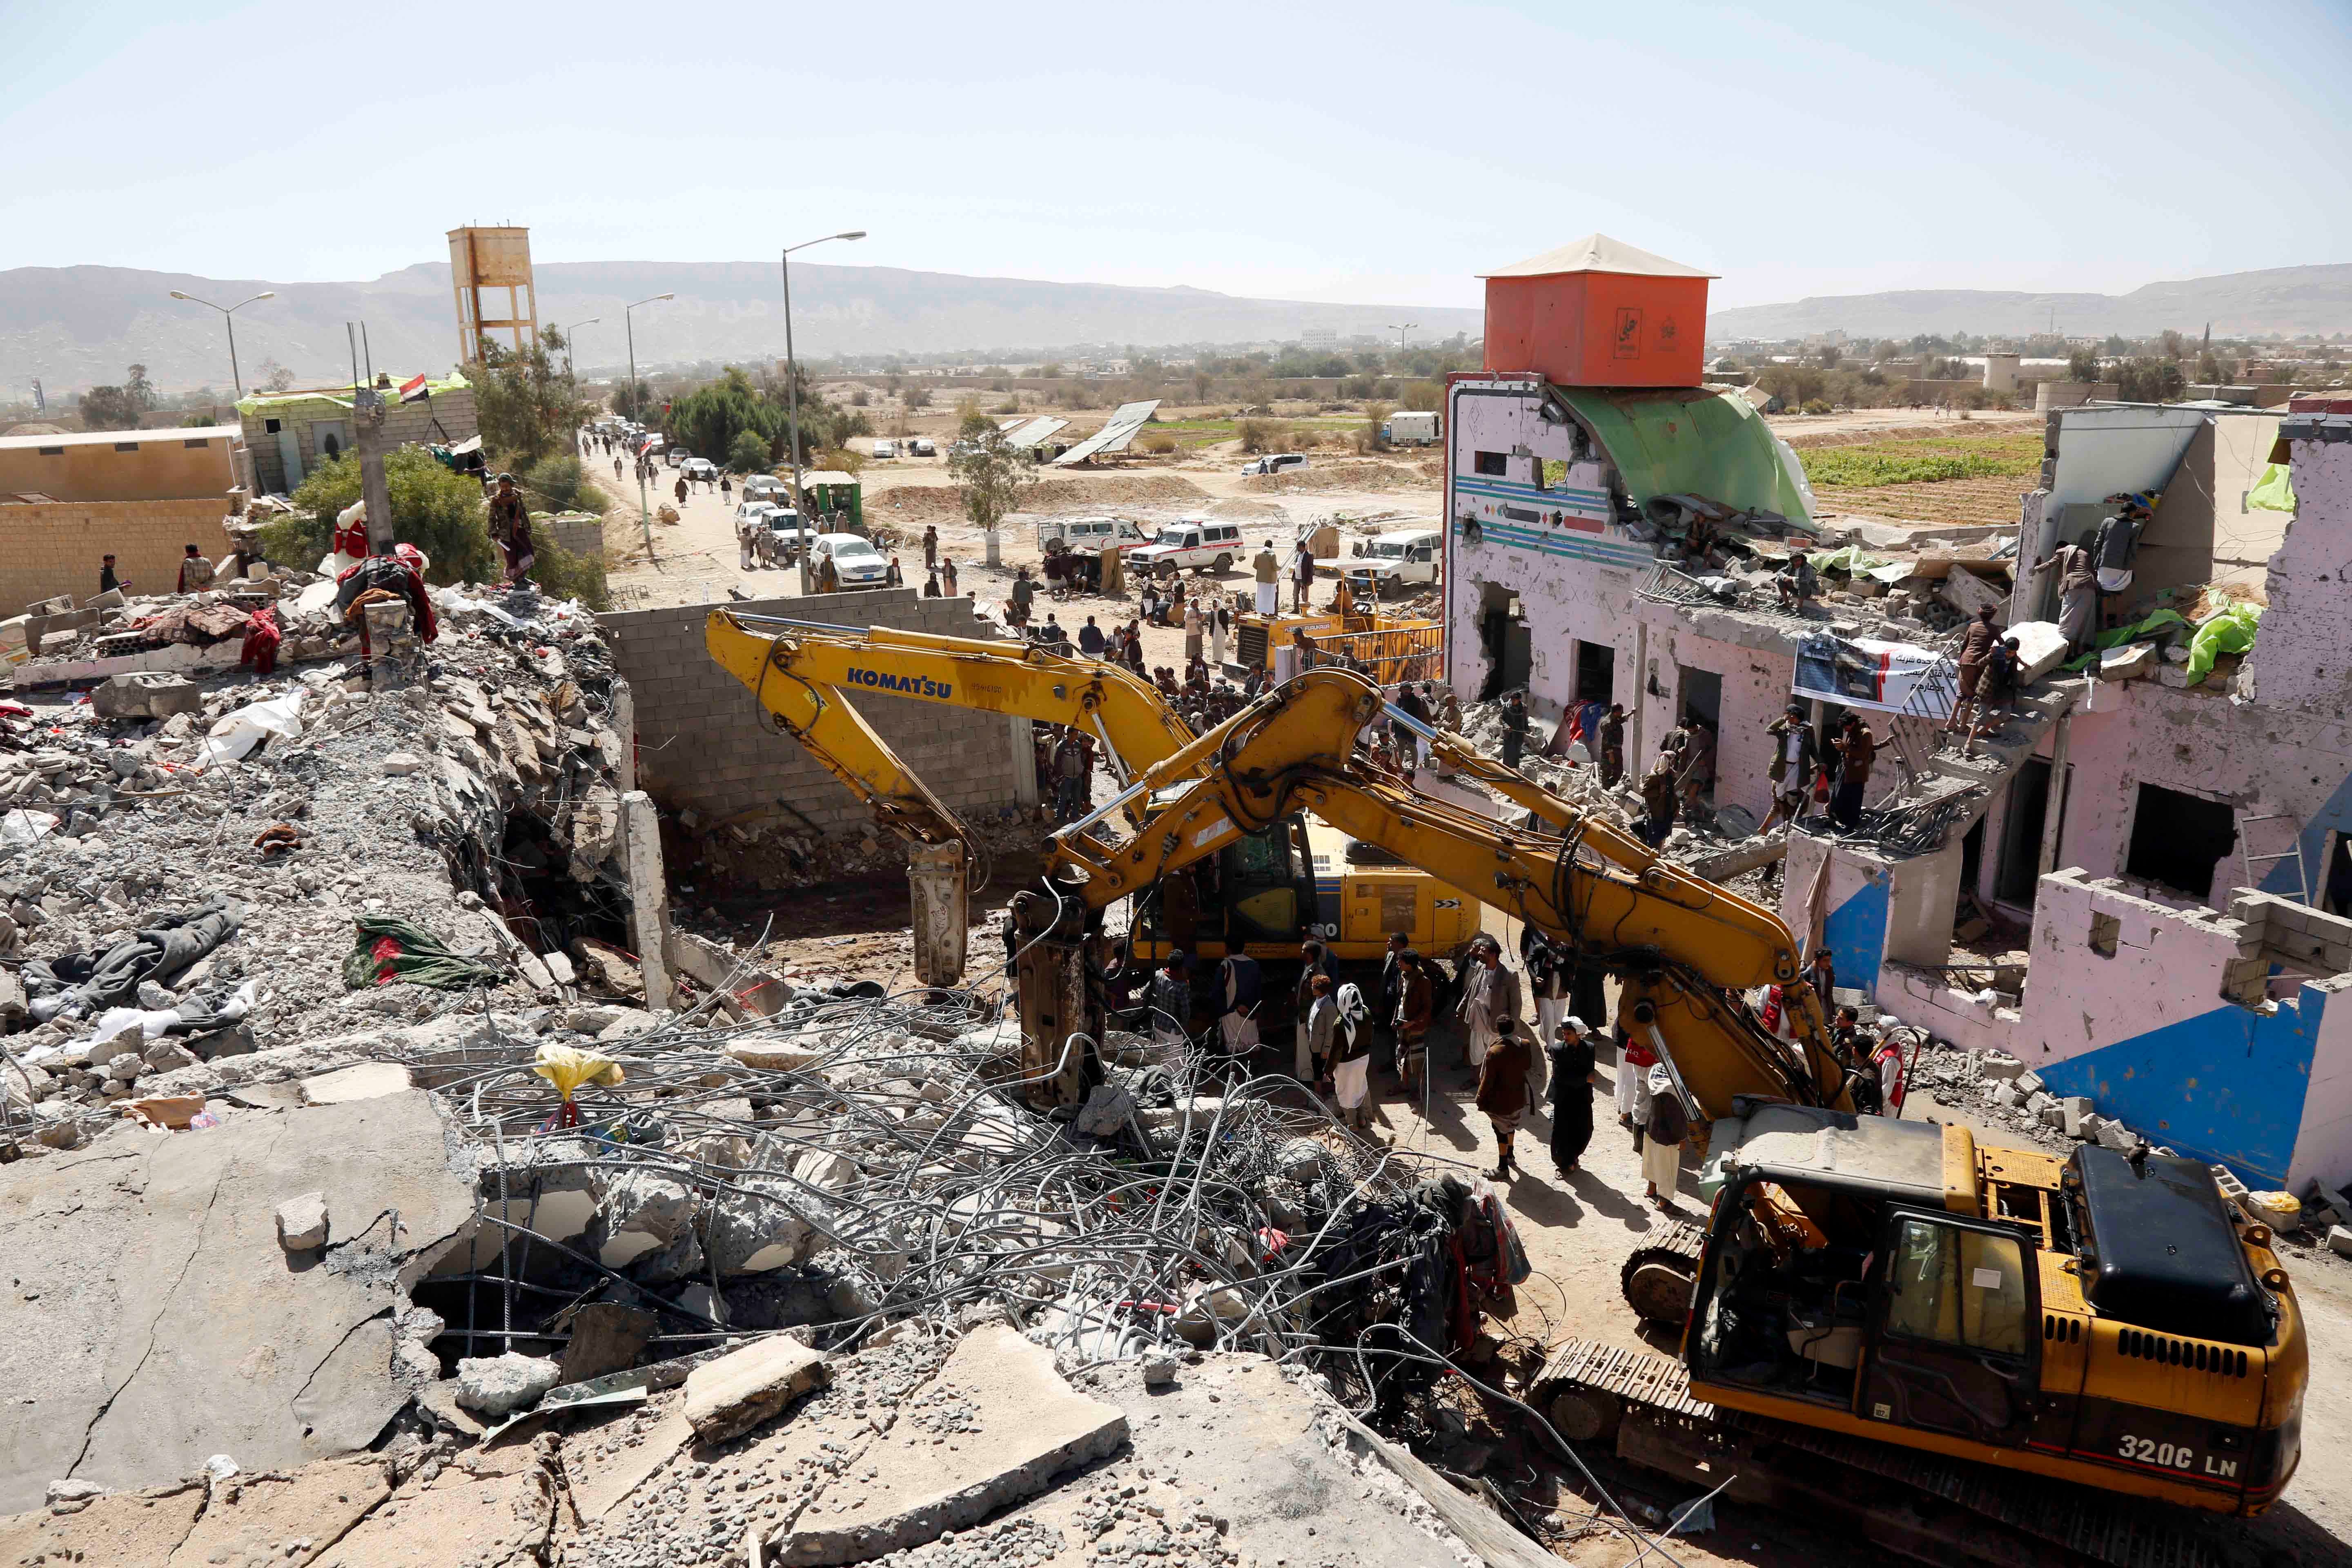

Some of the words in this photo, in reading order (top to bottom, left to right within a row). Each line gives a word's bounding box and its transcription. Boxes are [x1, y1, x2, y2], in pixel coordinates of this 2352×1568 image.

[1896, 654, 1915, 664] شريك
[847, 667, 952, 699] KOMATSU
[2118, 1434, 2194, 1469] 320C
[2205, 1456, 2238, 1477] LN
